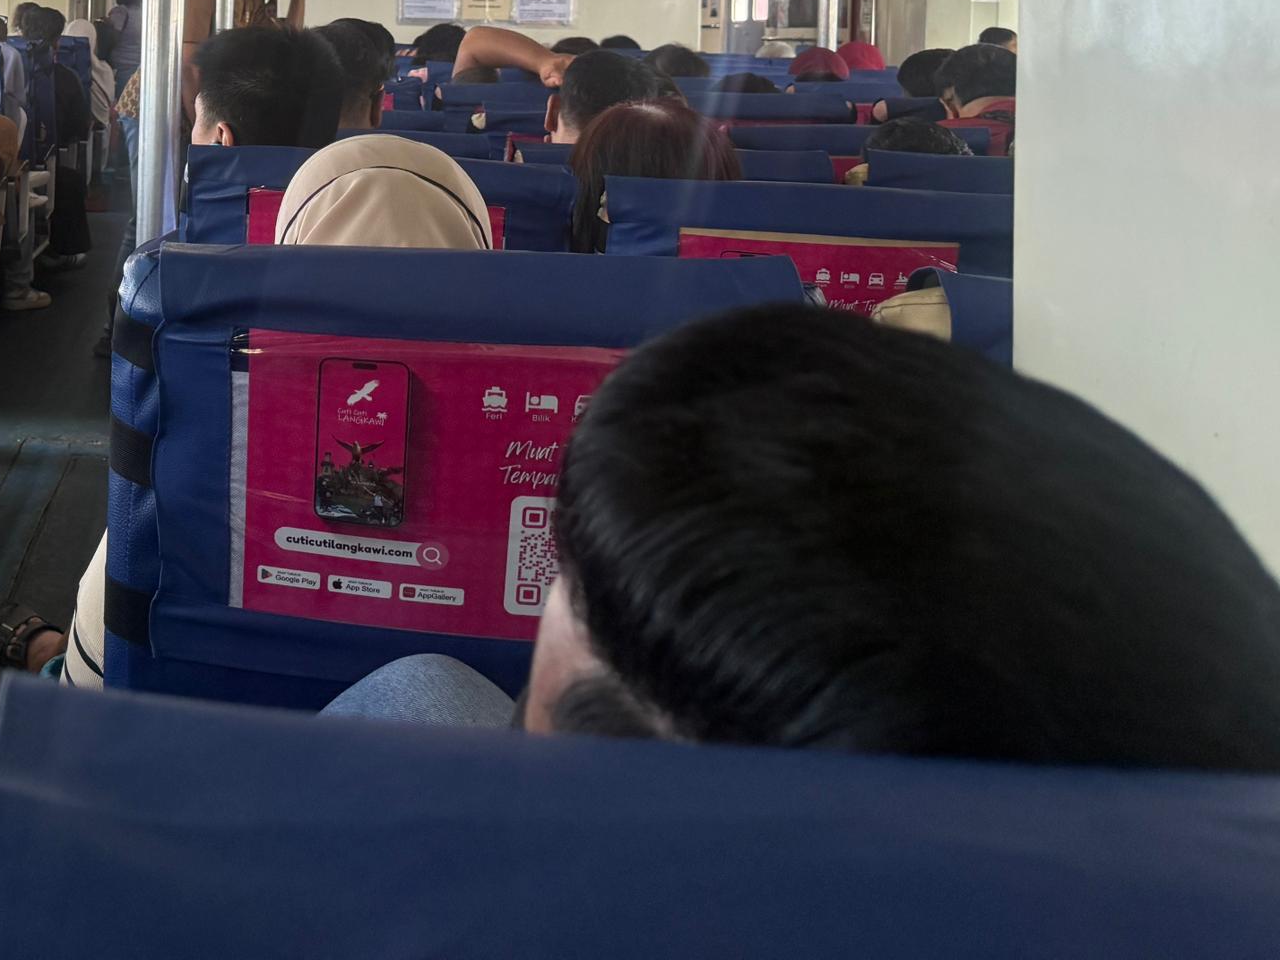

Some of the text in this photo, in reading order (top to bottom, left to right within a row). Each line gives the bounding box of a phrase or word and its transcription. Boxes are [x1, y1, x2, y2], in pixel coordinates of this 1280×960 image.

[338, 414, 385, 427] LANGKAWI
[532, 414, 551, 422] Bilik
[505, 440, 560, 462] Muat
[285, 534, 413, 559] cuticutilangkawi.com
[275, 574, 317, 587] Google Play
[345, 583, 360, 593] App
[361, 585, 380, 594] Store
[417, 591, 457, 602] AppGallery
